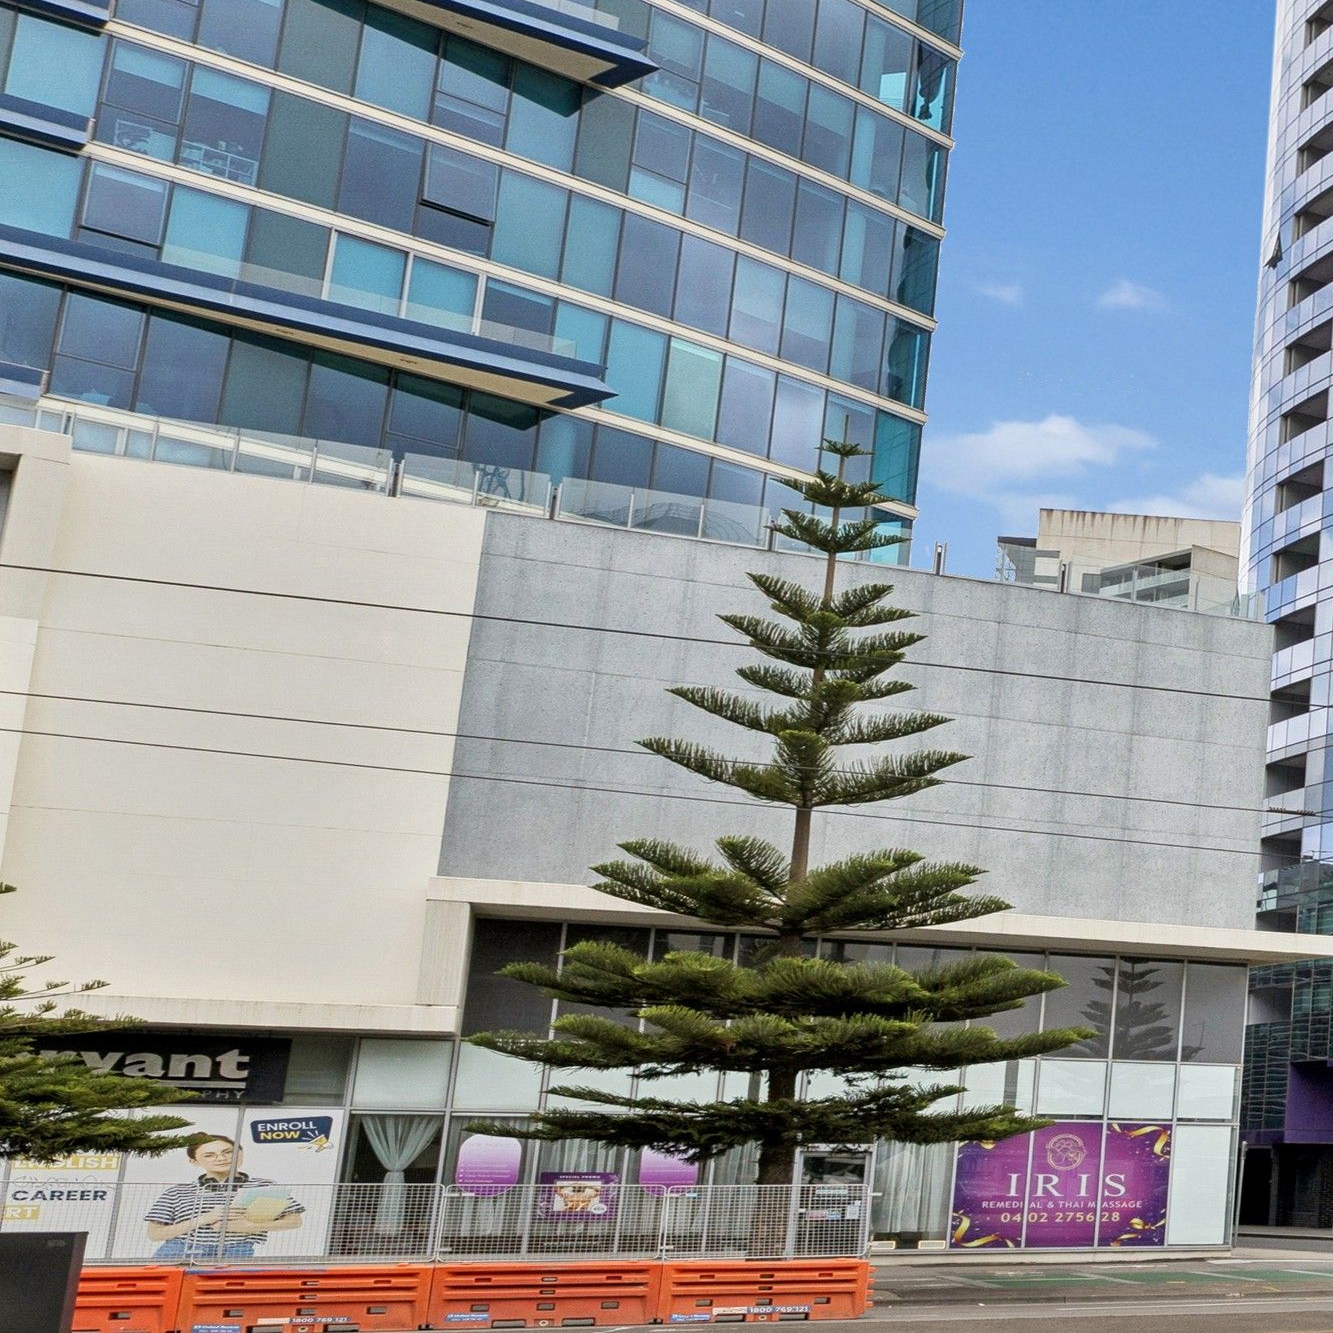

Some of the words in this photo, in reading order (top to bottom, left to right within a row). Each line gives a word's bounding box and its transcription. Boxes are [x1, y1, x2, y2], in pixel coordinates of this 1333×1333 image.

[257, 1121, 317, 1132] ENROLL
[260, 1130, 300, 1140] NOW
[13, 1155, 118, 1169] EGLISH
[1007, 1173, 1126, 1197] IRIS
[11, 1190, 107, 1201] CAREER
[982, 1200, 1042, 1209] REMEDIAL
[1058, 1200, 1084, 1209] THAI
[1087, 1200, 1143, 1208] MASSAGE
